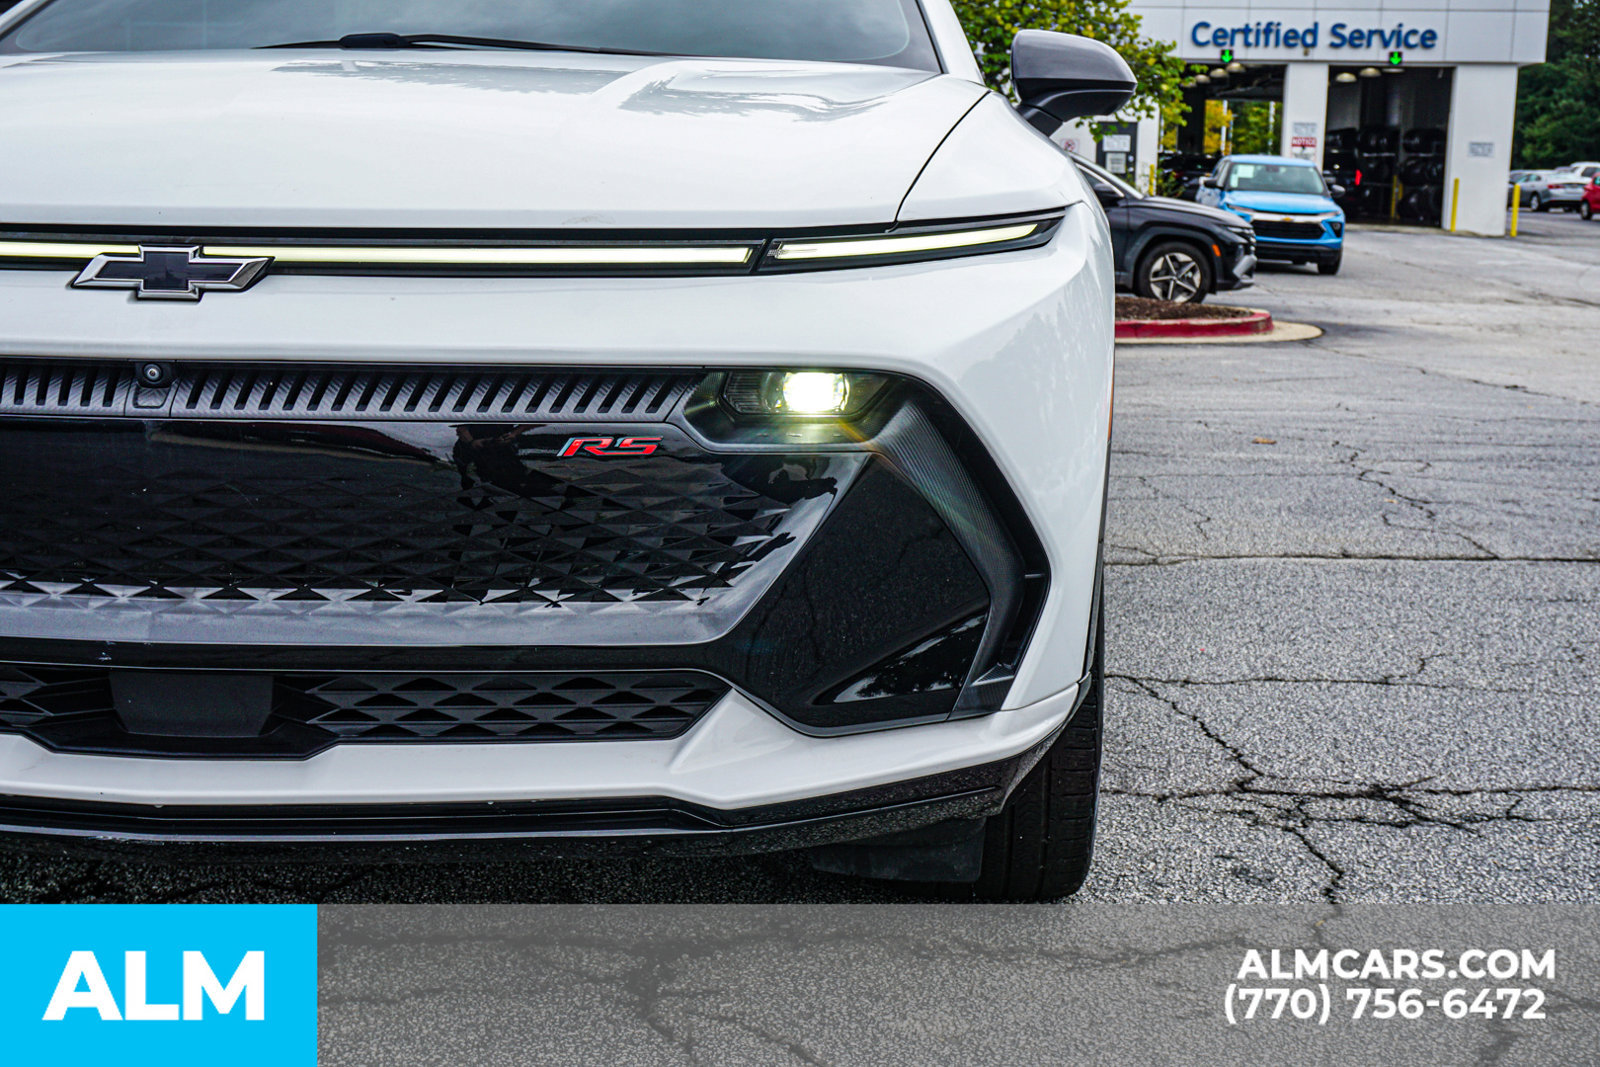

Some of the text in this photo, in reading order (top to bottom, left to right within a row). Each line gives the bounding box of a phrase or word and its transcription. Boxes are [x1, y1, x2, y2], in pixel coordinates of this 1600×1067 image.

[1191, 21, 1437, 49] Certified Service
[557, 436, 663, 457] RS
